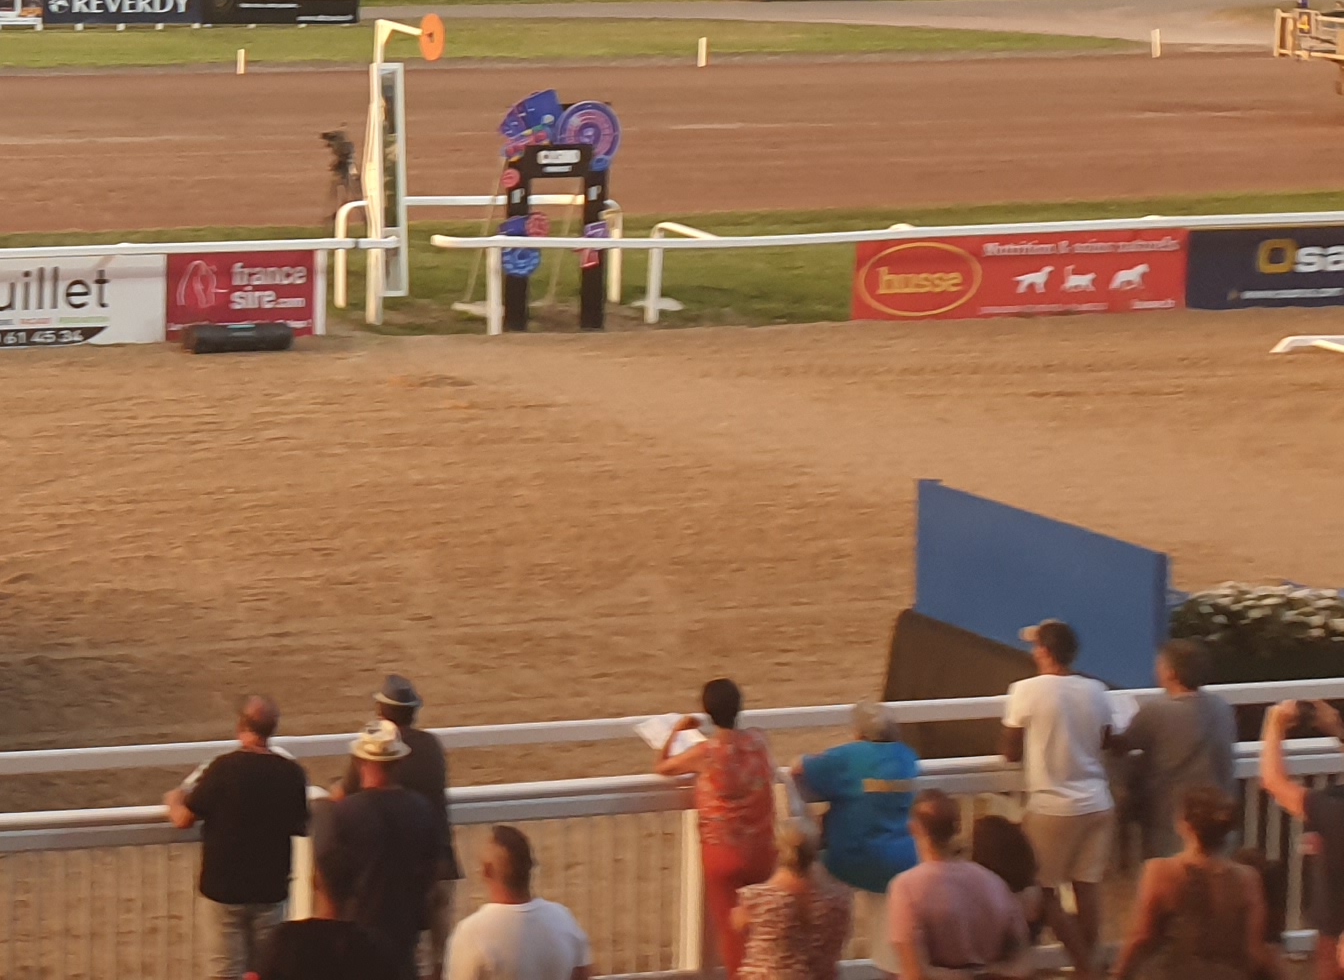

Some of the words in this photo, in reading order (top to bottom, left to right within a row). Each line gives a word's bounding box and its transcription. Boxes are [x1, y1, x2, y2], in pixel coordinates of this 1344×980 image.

[230, 261, 308, 286] france
[876, 265, 964, 295] husse
[3, 331, 28, 345] 61
[29, 330, 56, 344] 45
